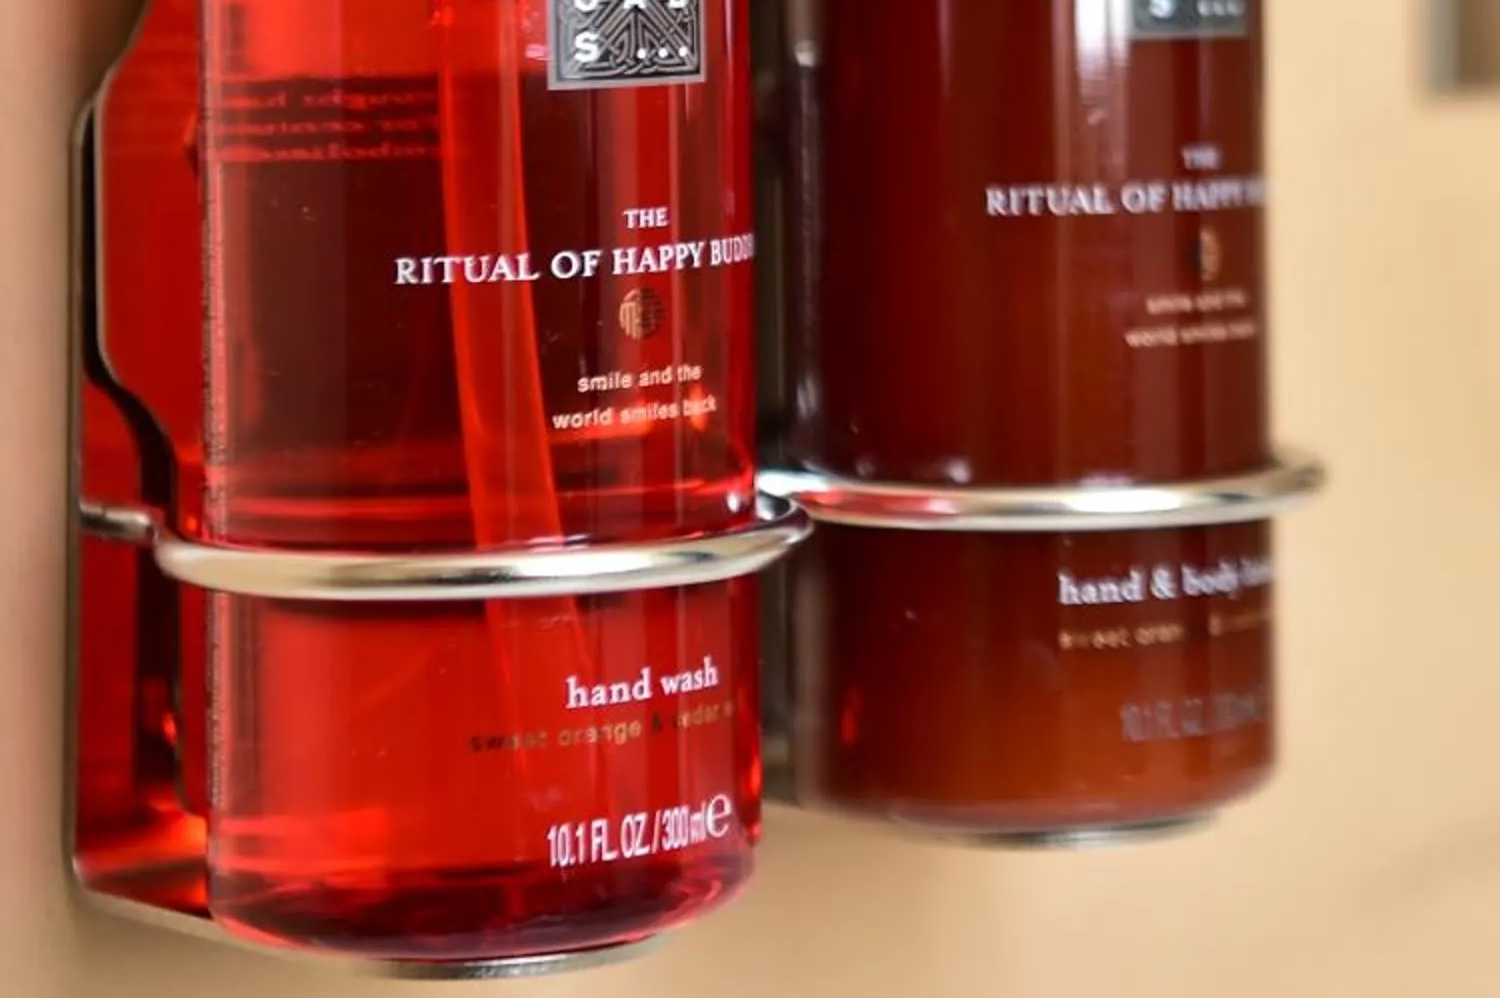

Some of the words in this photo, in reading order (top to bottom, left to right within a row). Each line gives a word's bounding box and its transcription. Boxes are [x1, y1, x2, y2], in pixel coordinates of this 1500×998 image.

[986, 184, 1115, 216] RITUAL
[1120, 182, 1166, 214] OF
[623, 207, 669, 229] THE
[394, 252, 541, 285] RITUAL
[551, 249, 604, 280] OF
[612, 241, 706, 276] HAPPY
[577, 371, 633, 393] smile
[639, 366, 673, 387] and
[677, 363, 703, 382] the
[552, 408, 614, 429] world
[619, 402, 680, 424] smiles
[683, 394, 718, 417] back
[1058, 565, 1143, 605] hand
[1151, 563, 1177, 600] &
[565, 666, 651, 709] hand
[660, 654, 719, 696] wash
[558, 719, 642, 746] orange
[547, 821, 587, 868] 10.1
